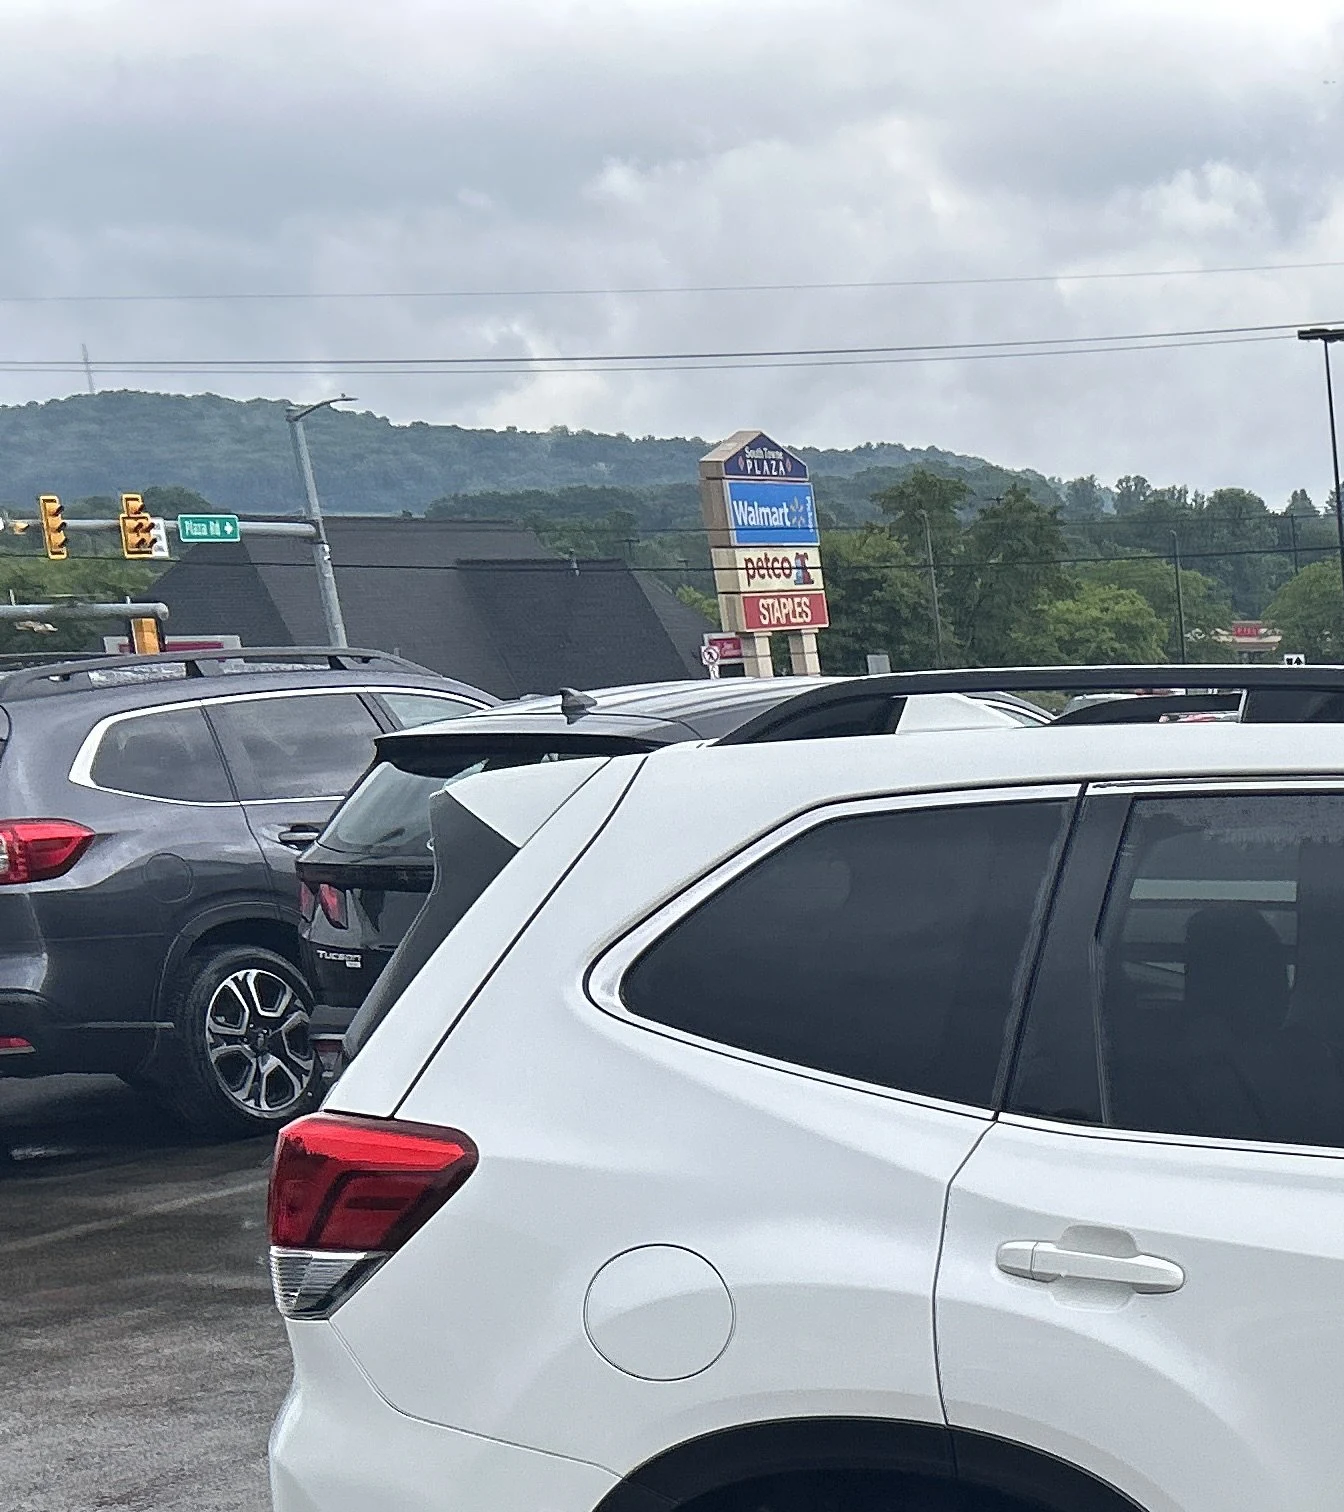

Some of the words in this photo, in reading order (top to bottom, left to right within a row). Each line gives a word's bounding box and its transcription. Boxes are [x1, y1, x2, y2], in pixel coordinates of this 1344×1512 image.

[746, 460, 786, 475] PLAZA
[732, 500, 791, 527] Walmart
[184, 520, 208, 536] Plaza
[743, 552, 793, 587] petco
[758, 597, 812, 625] STAPLES
